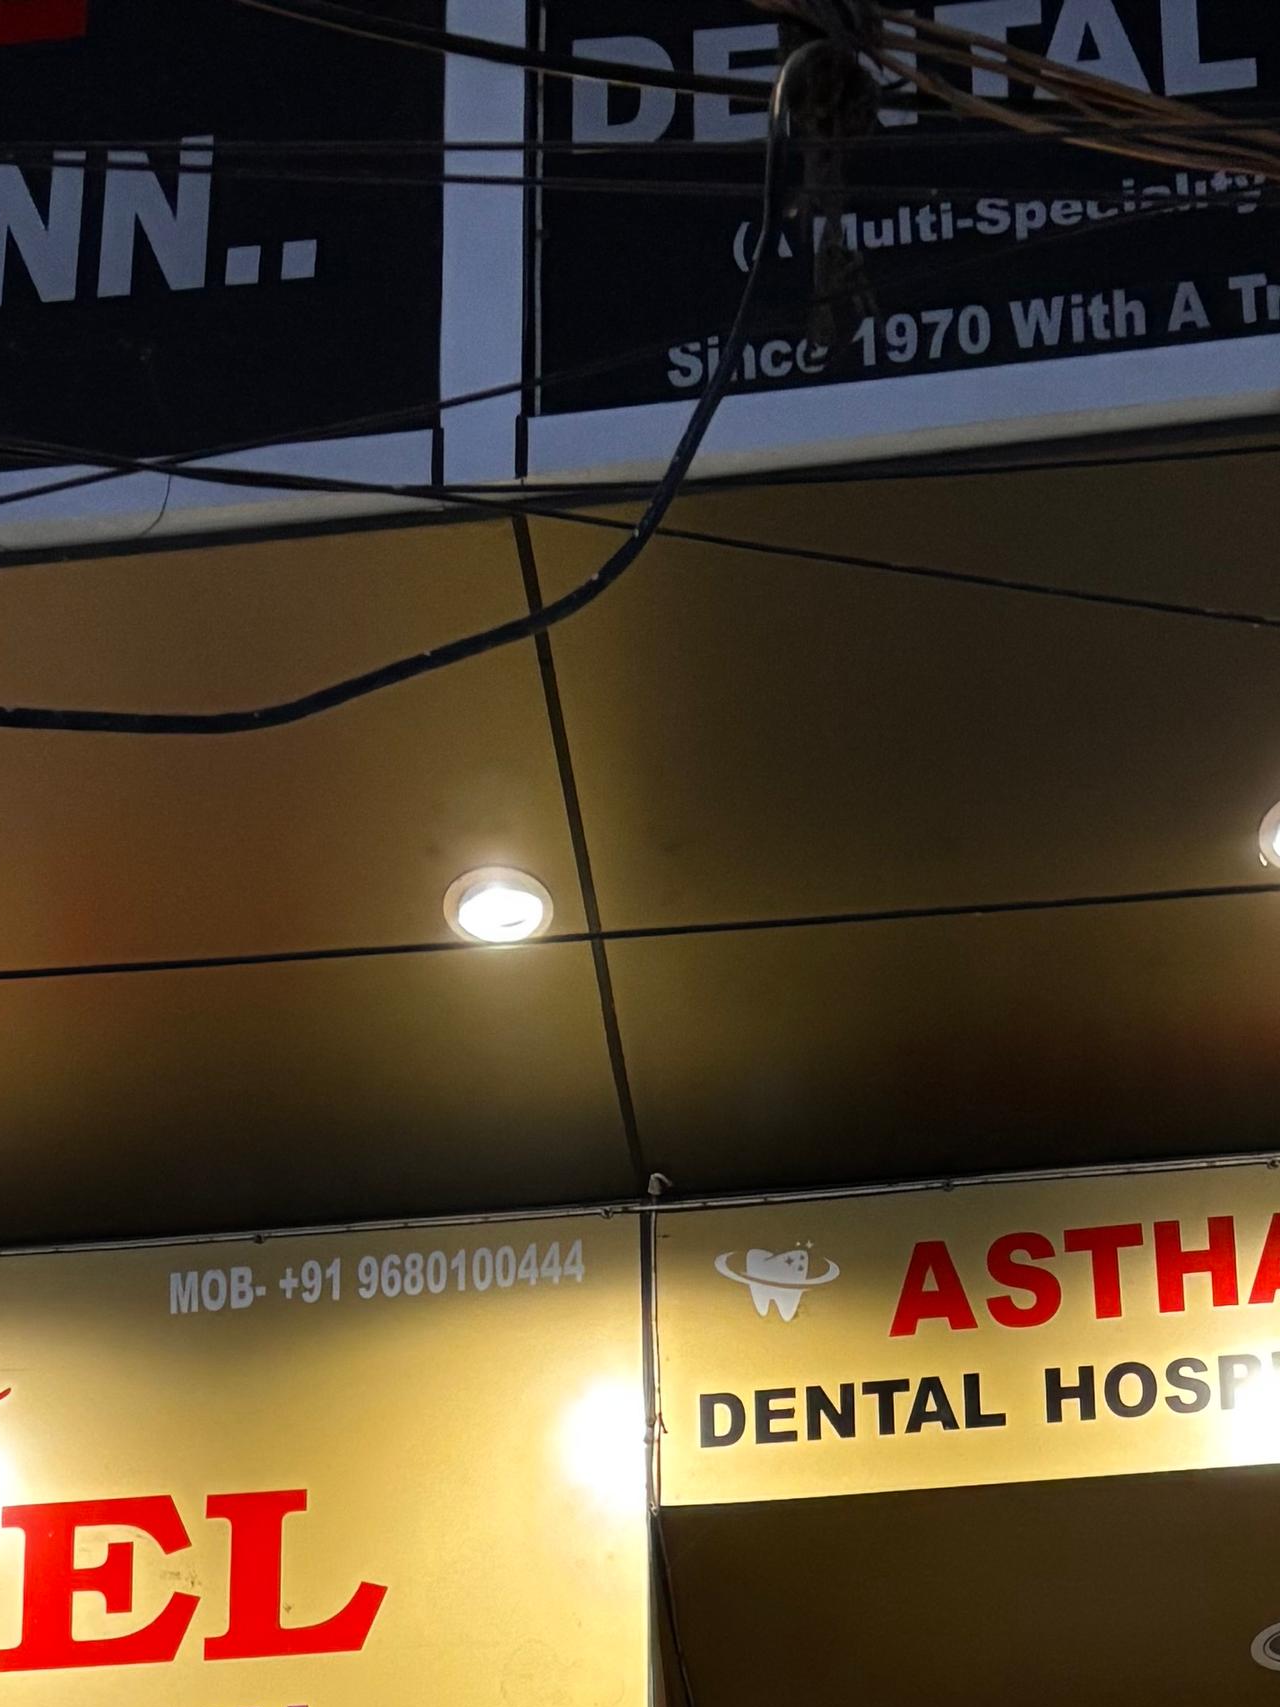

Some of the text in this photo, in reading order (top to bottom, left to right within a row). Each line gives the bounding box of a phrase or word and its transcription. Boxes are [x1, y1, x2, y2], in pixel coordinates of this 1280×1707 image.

[667, 336, 829, 389] Since
[853, 304, 990, 366] 1970
[1010, 289, 1145, 349] With
[1168, 281, 1209, 333] A
[170, 1240, 586, 1314] MOB- +91 9680100444
[699, 1372, 1006, 1449] DENTAL
